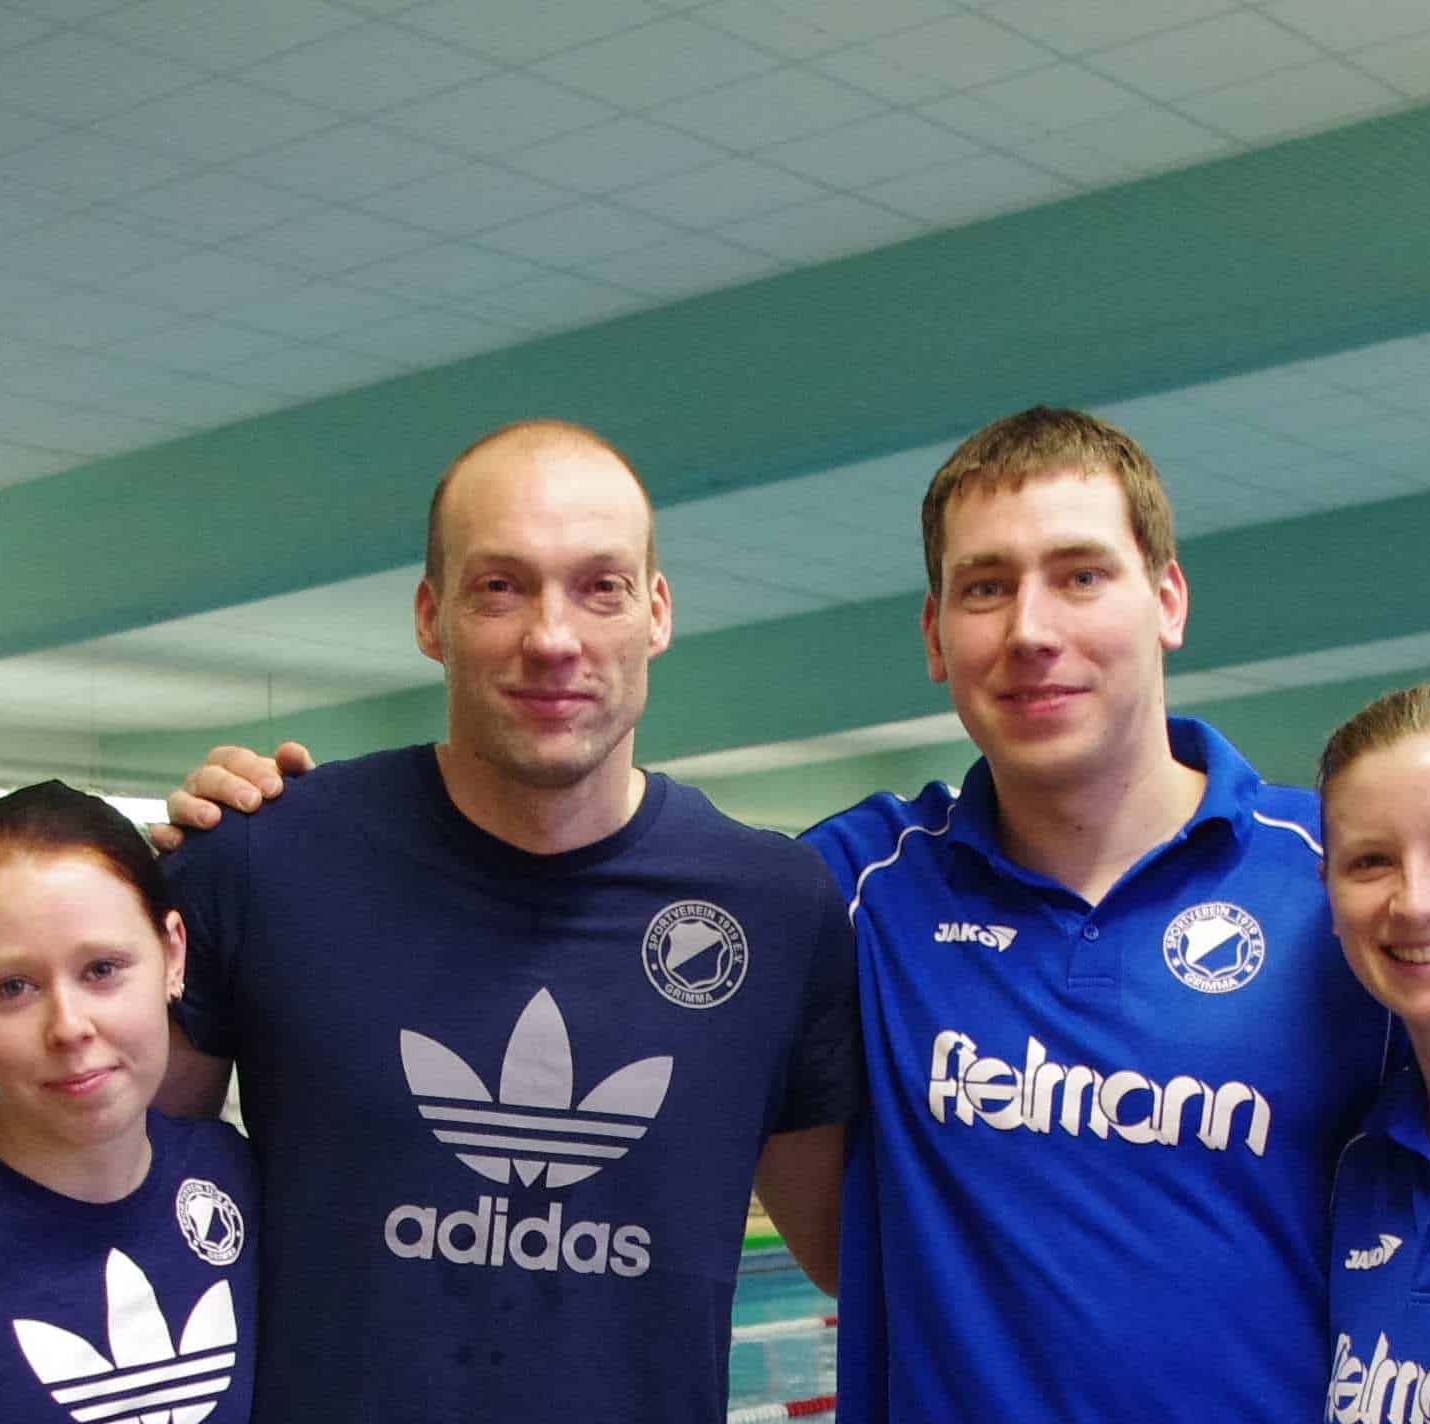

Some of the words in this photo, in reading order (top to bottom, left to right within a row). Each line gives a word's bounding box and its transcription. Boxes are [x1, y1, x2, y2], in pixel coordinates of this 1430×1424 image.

[648, 905, 716, 951] SPORTVEREIN
[934, 922, 998, 947] JAKO
[665, 983, 713, 1005] GRIMMA
[1184, 973, 1239, 992] GRIMMA
[383, 1195, 651, 1278] adidas
